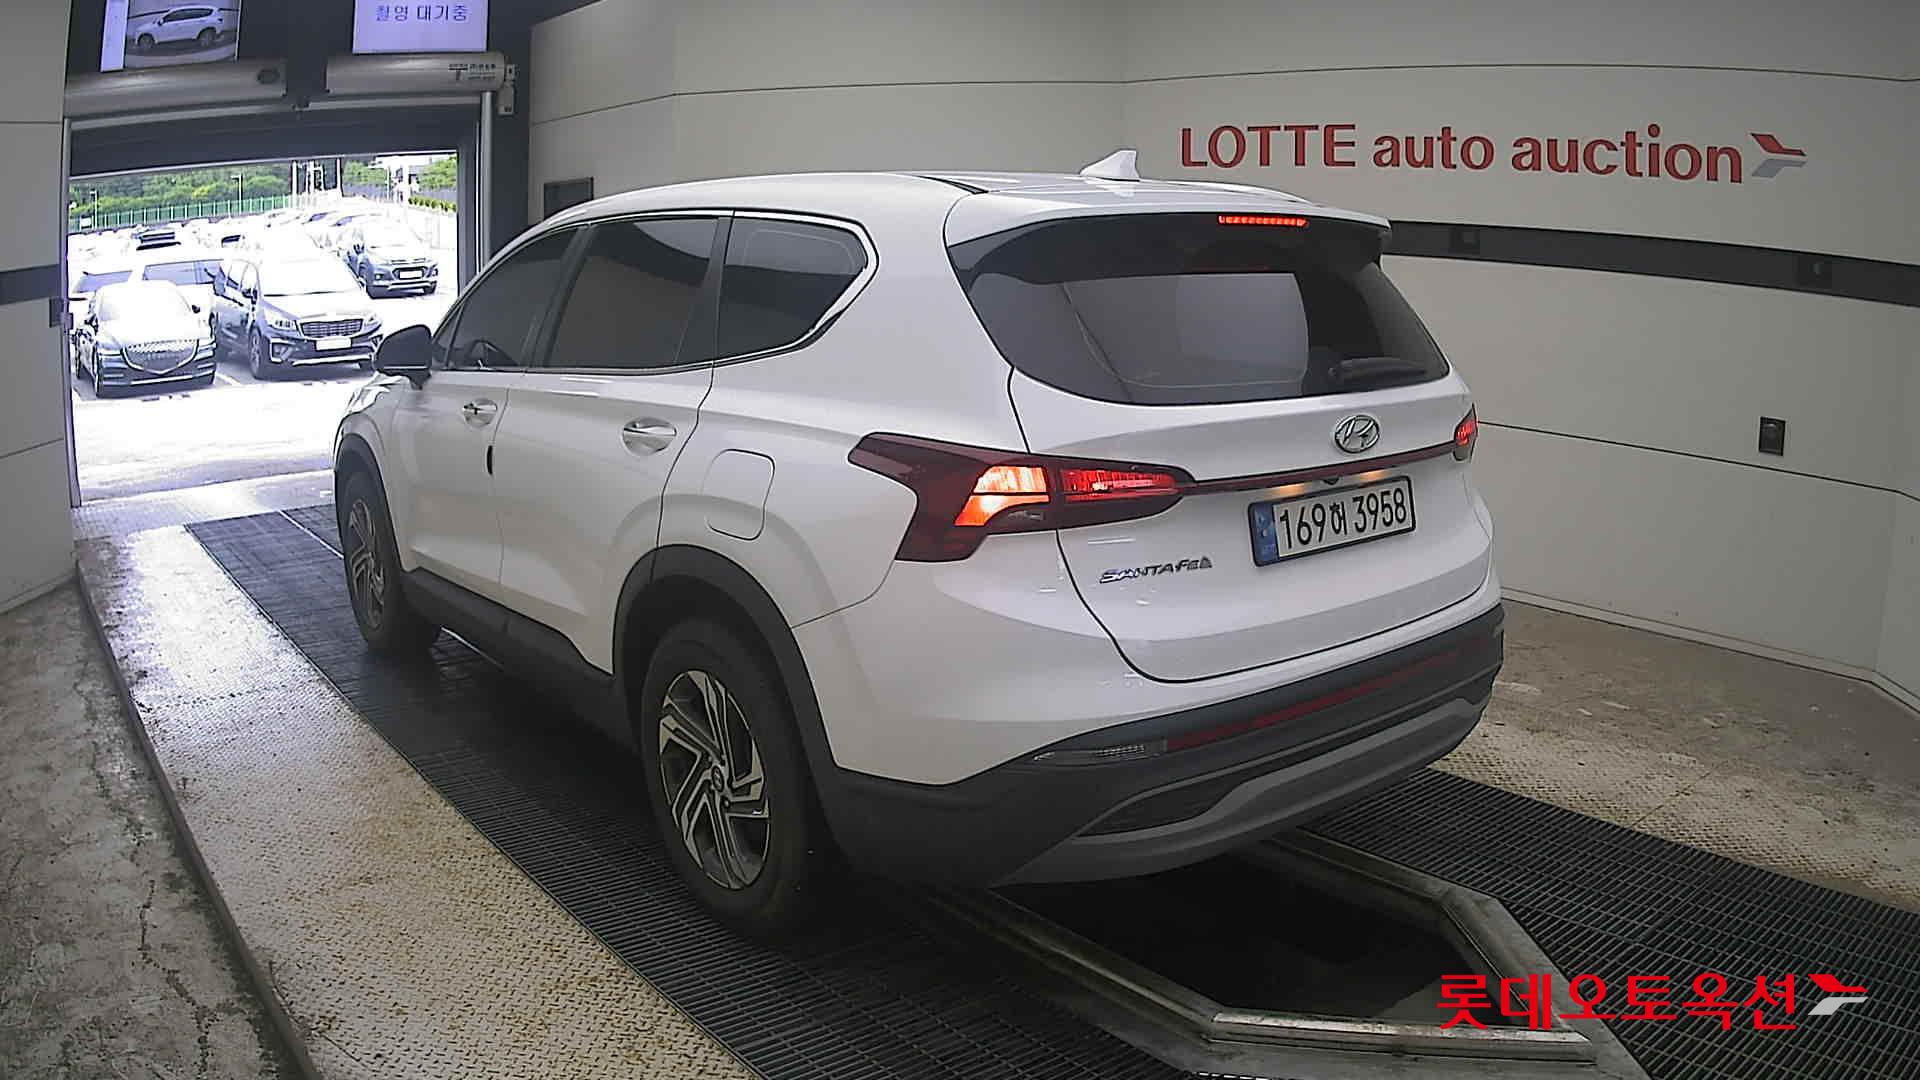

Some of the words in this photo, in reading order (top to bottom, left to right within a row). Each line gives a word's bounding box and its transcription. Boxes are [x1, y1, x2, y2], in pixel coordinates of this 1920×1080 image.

[1180, 123, 1357, 169] LOTTE
[1372, 126, 1496, 171] auto
[1511, 123, 1743, 184] auction
[1279, 500, 1348, 549] 169허
[1352, 487, 1407, 533] 3958
